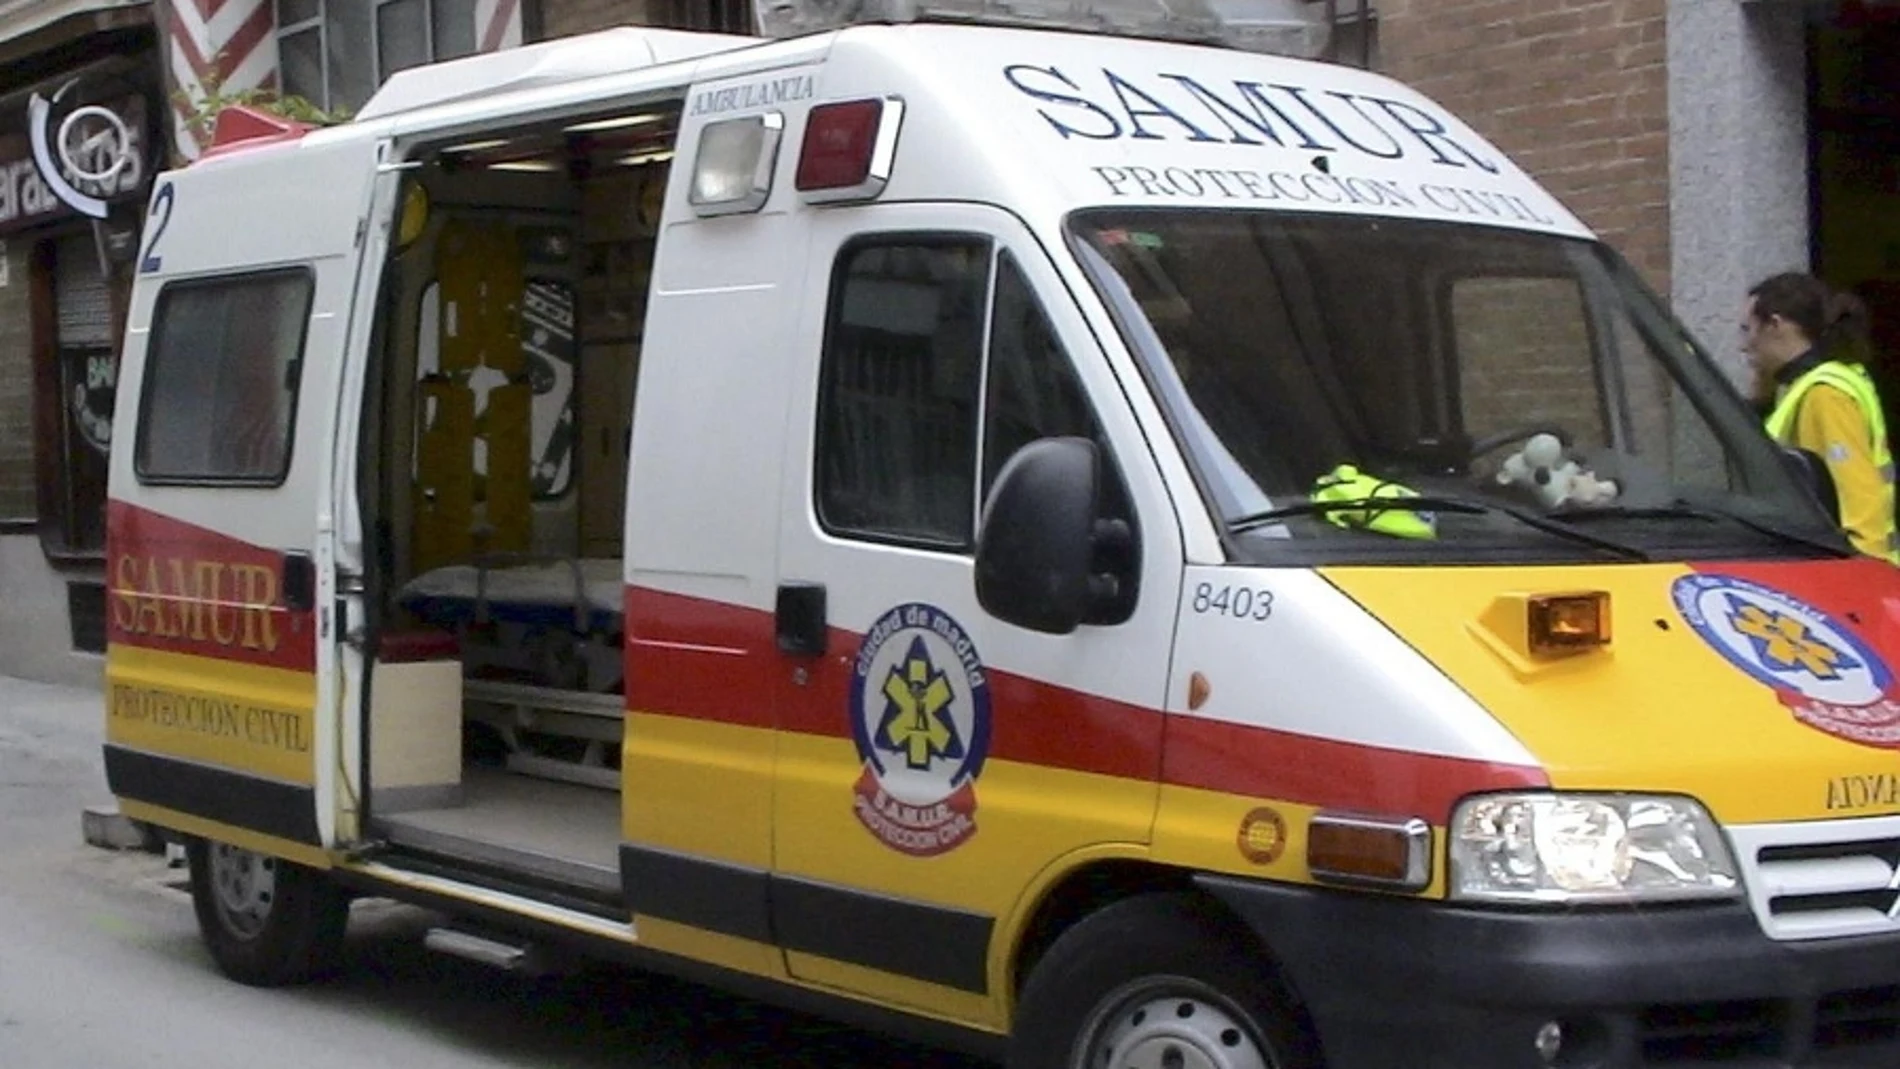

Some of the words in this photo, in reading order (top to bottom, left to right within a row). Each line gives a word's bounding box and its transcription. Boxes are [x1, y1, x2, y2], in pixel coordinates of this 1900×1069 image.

[689, 75, 814, 116] AMBULANCIA
[1003, 64, 1498, 175] SAMUR
[140, 181, 174, 273] 2
[1421, 183, 1554, 226] CIVIL
[113, 554, 281, 652] SAMUR
[1193, 582, 1275, 622] 8403
[905, 606, 929, 625] de
[933, 616, 986, 688] madrid
[245, 707, 309, 752] CIVIL
